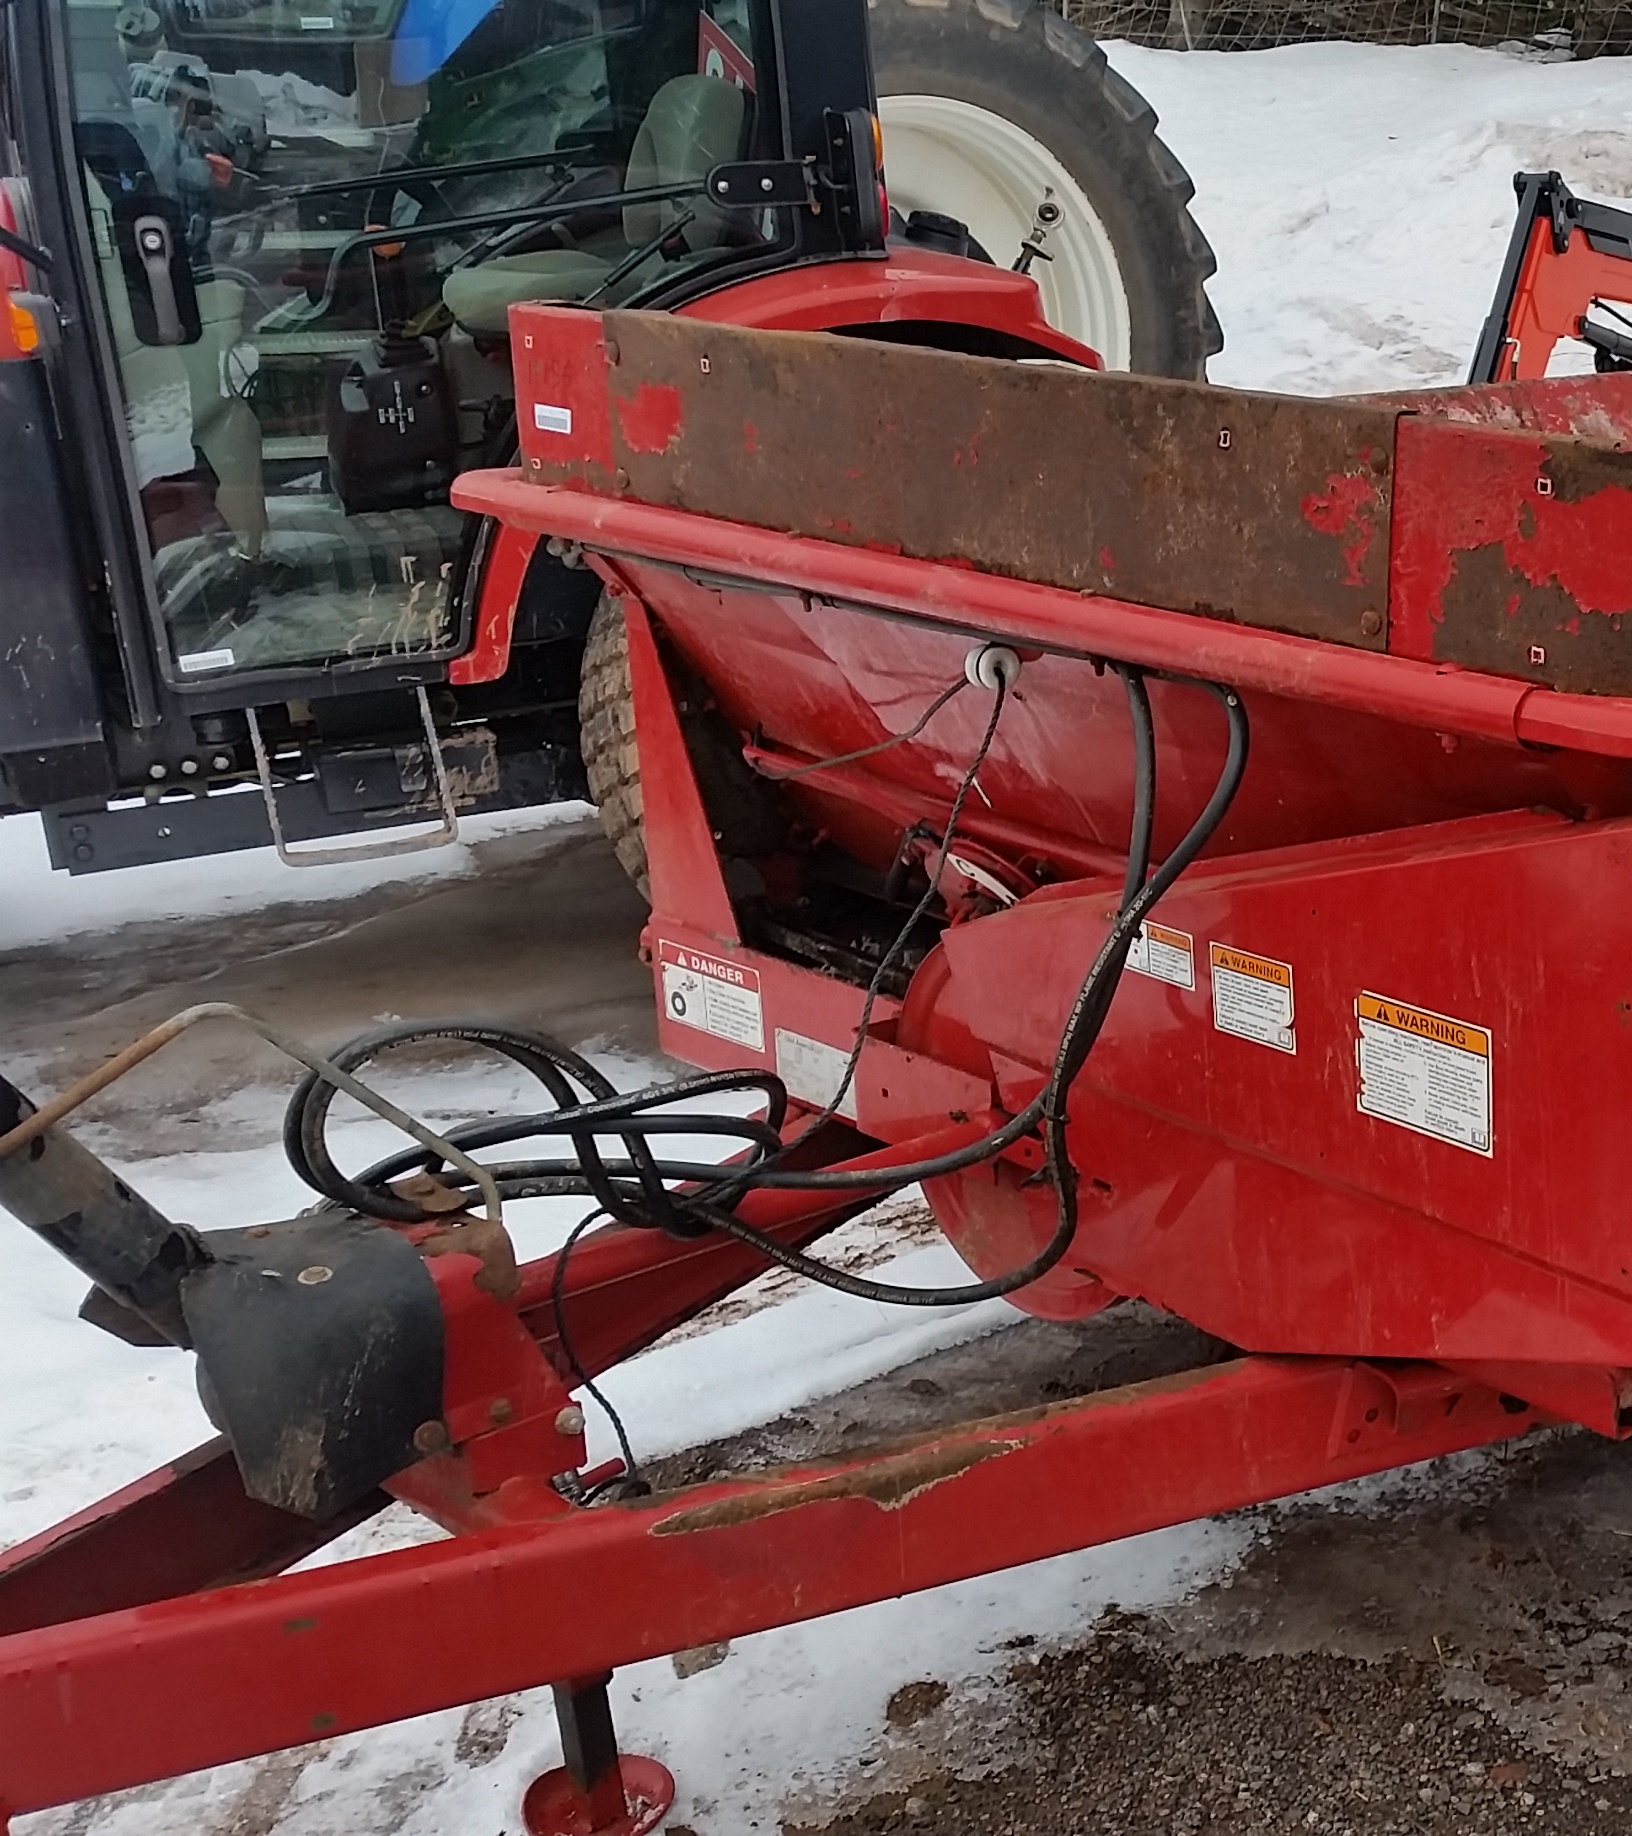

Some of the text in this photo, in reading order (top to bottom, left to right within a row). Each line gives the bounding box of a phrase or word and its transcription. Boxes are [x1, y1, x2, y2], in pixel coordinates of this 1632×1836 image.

[691, 956, 744, 985] DANGER
[1080, 975, 1096, 1002] FLAME
[1092, 935, 1117, 977] RESISTANT
[1231, 955, 1282, 981] WARNING
[1396, 1010, 1466, 1045] WARNING
